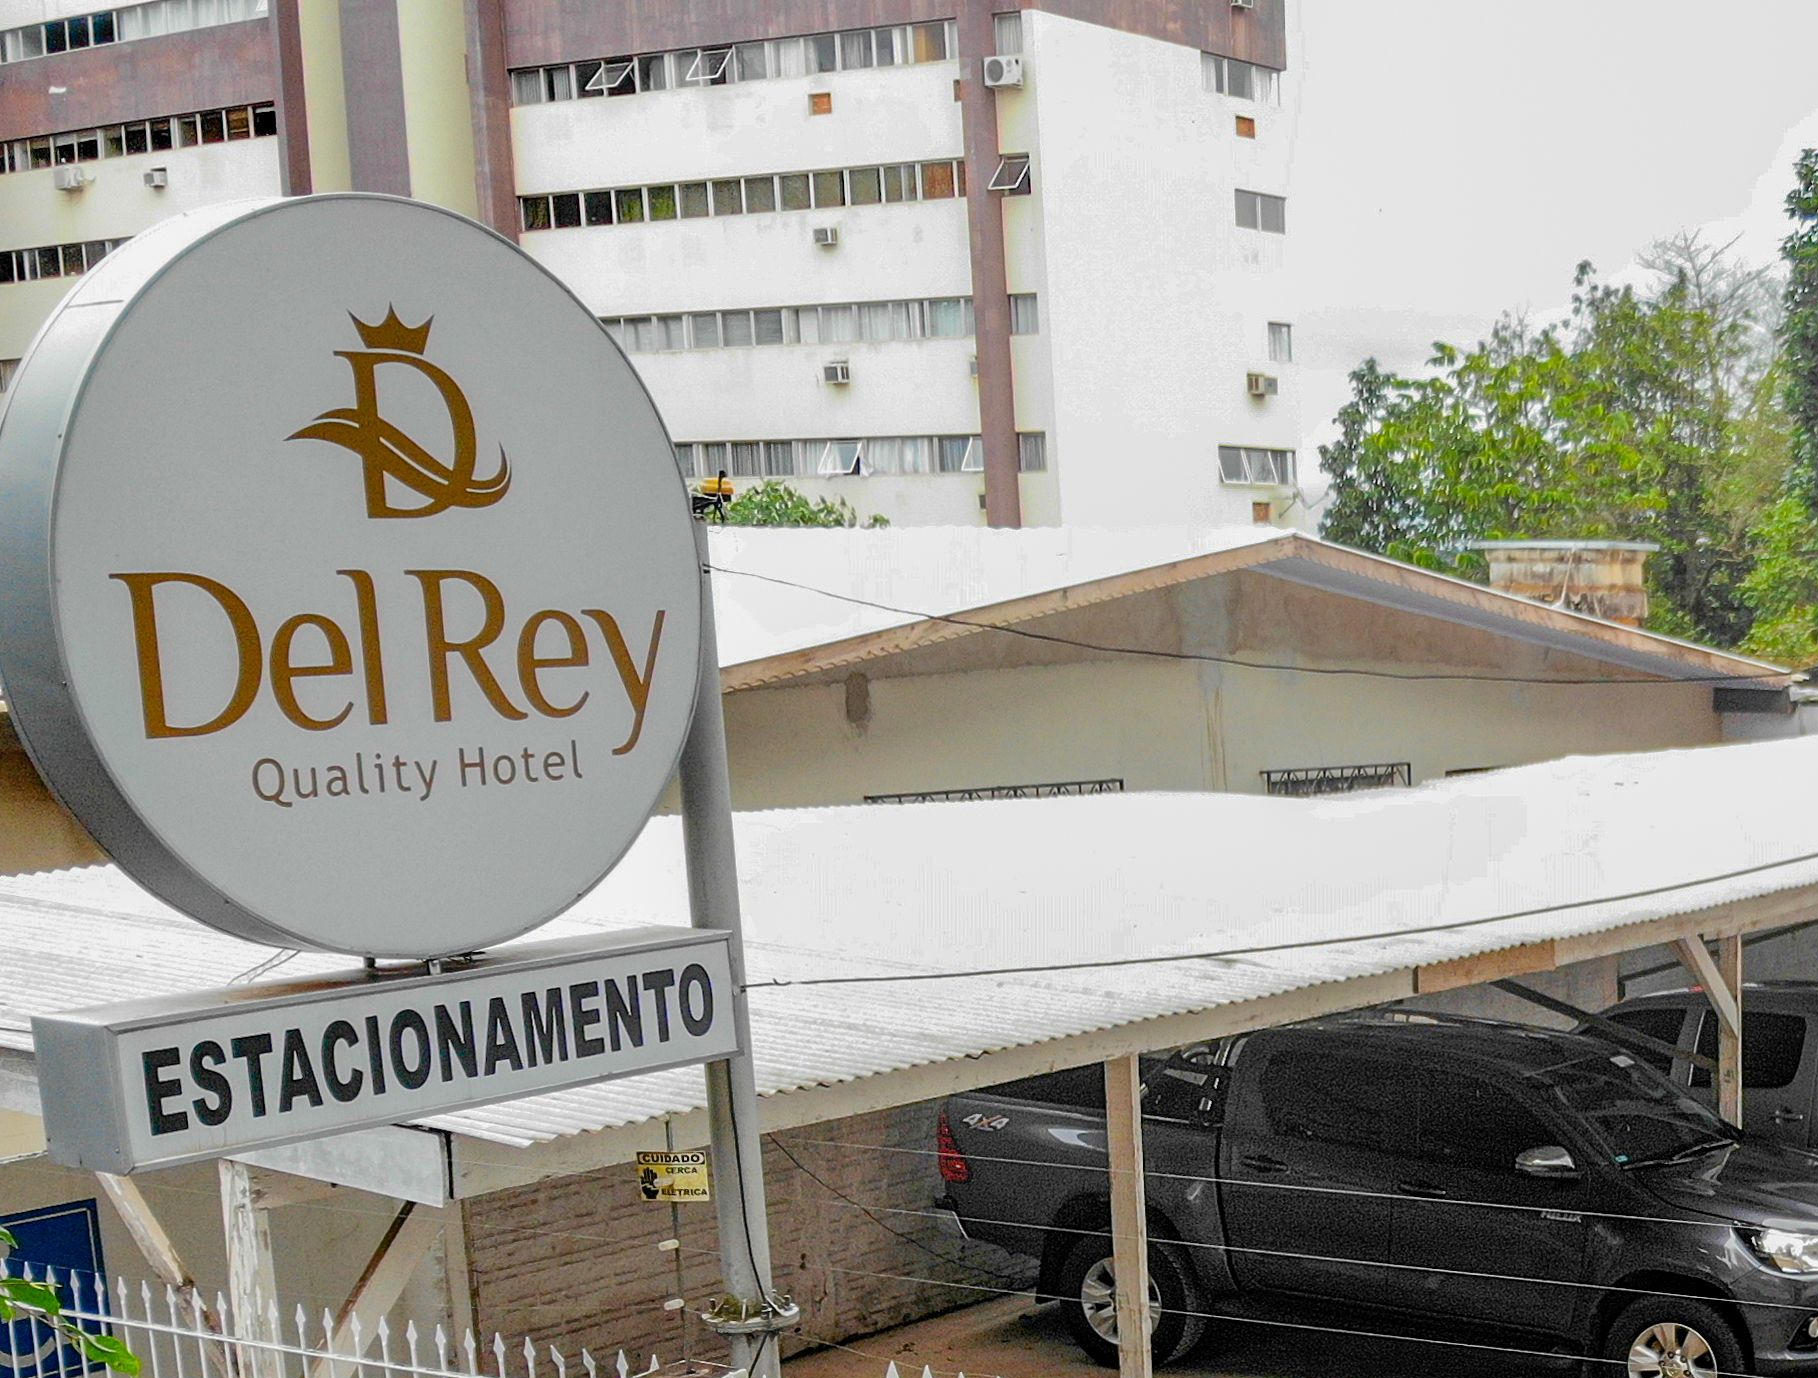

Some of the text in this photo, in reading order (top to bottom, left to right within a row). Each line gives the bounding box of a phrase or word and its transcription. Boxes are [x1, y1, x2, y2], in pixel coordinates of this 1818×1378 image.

[109, 568, 667, 756] Del Rey
[251, 739, 584, 808] Quality Hotel
[141, 962, 715, 1137] ESTACIONAMENTO
[642, 1153, 701, 1163] CUIDADO
[665, 1166, 698, 1175] CERCA
